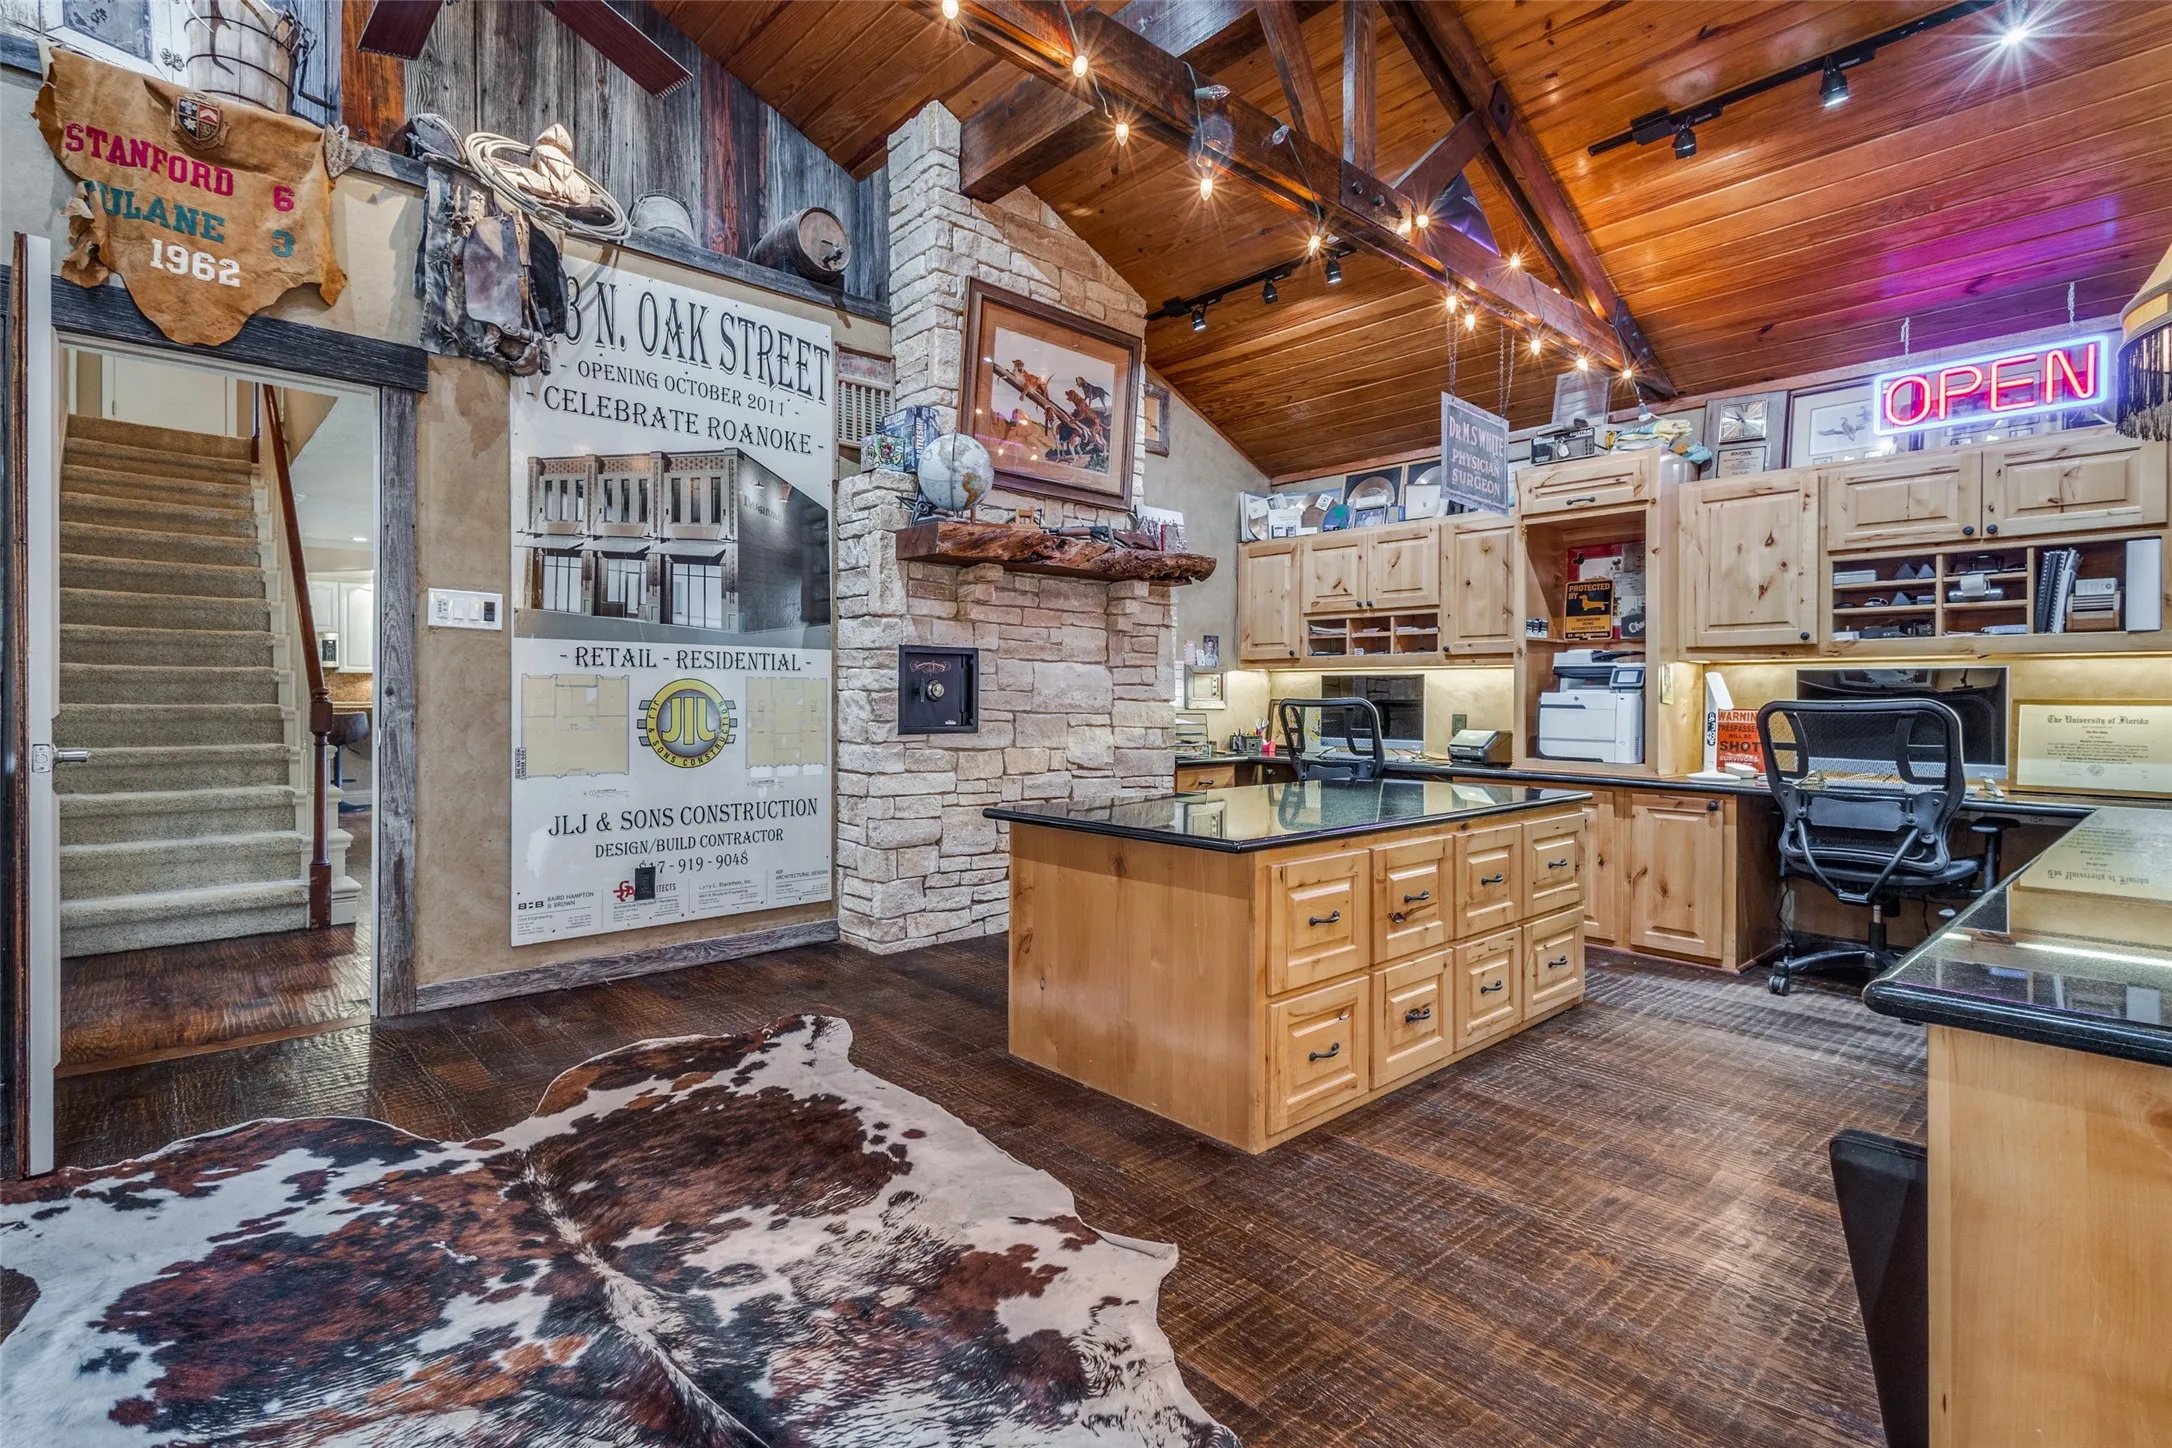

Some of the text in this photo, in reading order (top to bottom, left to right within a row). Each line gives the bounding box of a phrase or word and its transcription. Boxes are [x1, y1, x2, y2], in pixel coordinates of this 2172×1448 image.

[65, 123, 295, 212] STANFORD 6
[272, 230, 295, 258] 3
[150, 238, 241, 288] 1962
[595, 281, 627, 351] N.
[638, 291, 712, 370] OAK
[719, 311, 830, 406] STREET
[577, 360, 786, 417] OPENING OCTOBER 2011
[1884, 343, 2097, 427] OPEN
[543, 385, 812, 455] CELEBRATE ROANOKE
[1452, 448, 1500, 478] PHYSICIAN
[1451, 468, 1501, 497] SURGEON
[1568, 583, 1610, 593] PROTECTED
[1568, 592, 1578, 600] BY
[575, 646, 801, 672] RETAIL RESIDENTIAL
[1718, 711, 1759, 722] WARNIN
[1718, 724, 1756, 732] TRESPASSE
[2047, 714, 2150, 725] The University of Florida
[652, 740, 677, 763] SONS
[682, 700, 730, 767] CONSTRUCTION
[1719, 740, 1761, 752] SHOT
[548, 798, 819, 836] JLJ & SONS CONSTRUCTION
[595, 828, 784, 858] DESIGN/BUILD CONTRACTOR
[678, 856, 704, 874] 919
[715, 851, 749, 870] 9048
[547, 891, 595, 902] BAIRD HAMPTON
[656, 882, 677, 893] ITECTS
[553, 900, 576, 908] BROWN
